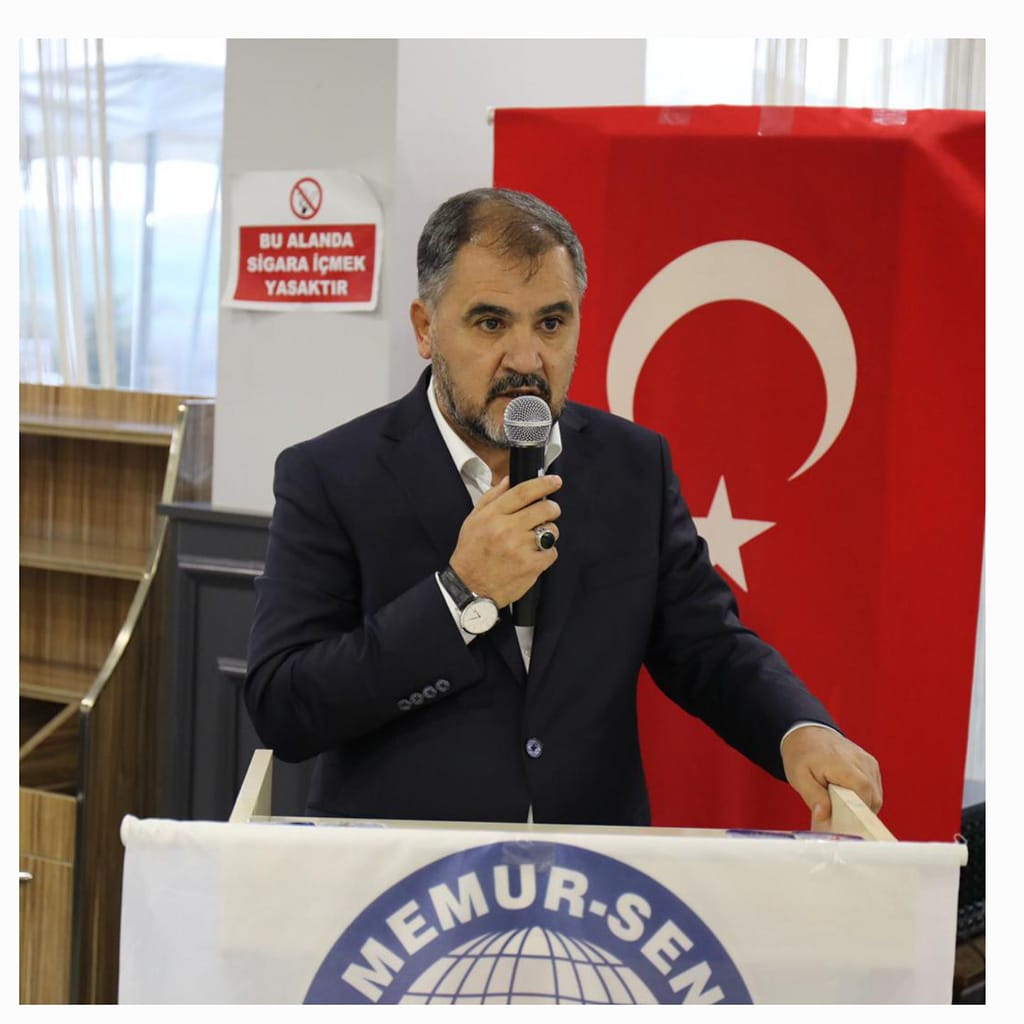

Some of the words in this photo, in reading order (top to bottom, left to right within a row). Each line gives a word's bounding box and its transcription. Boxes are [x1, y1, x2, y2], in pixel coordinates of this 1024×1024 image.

[259, 232, 283, 249] BU
[287, 231, 354, 248] ALANDA
[247, 253, 309, 272] SİGARA
[313, 253, 366, 275] İÇMEK
[264, 279, 348, 296] YASAKTIR
[341, 863, 725, 1004] MEMUR-SEN
